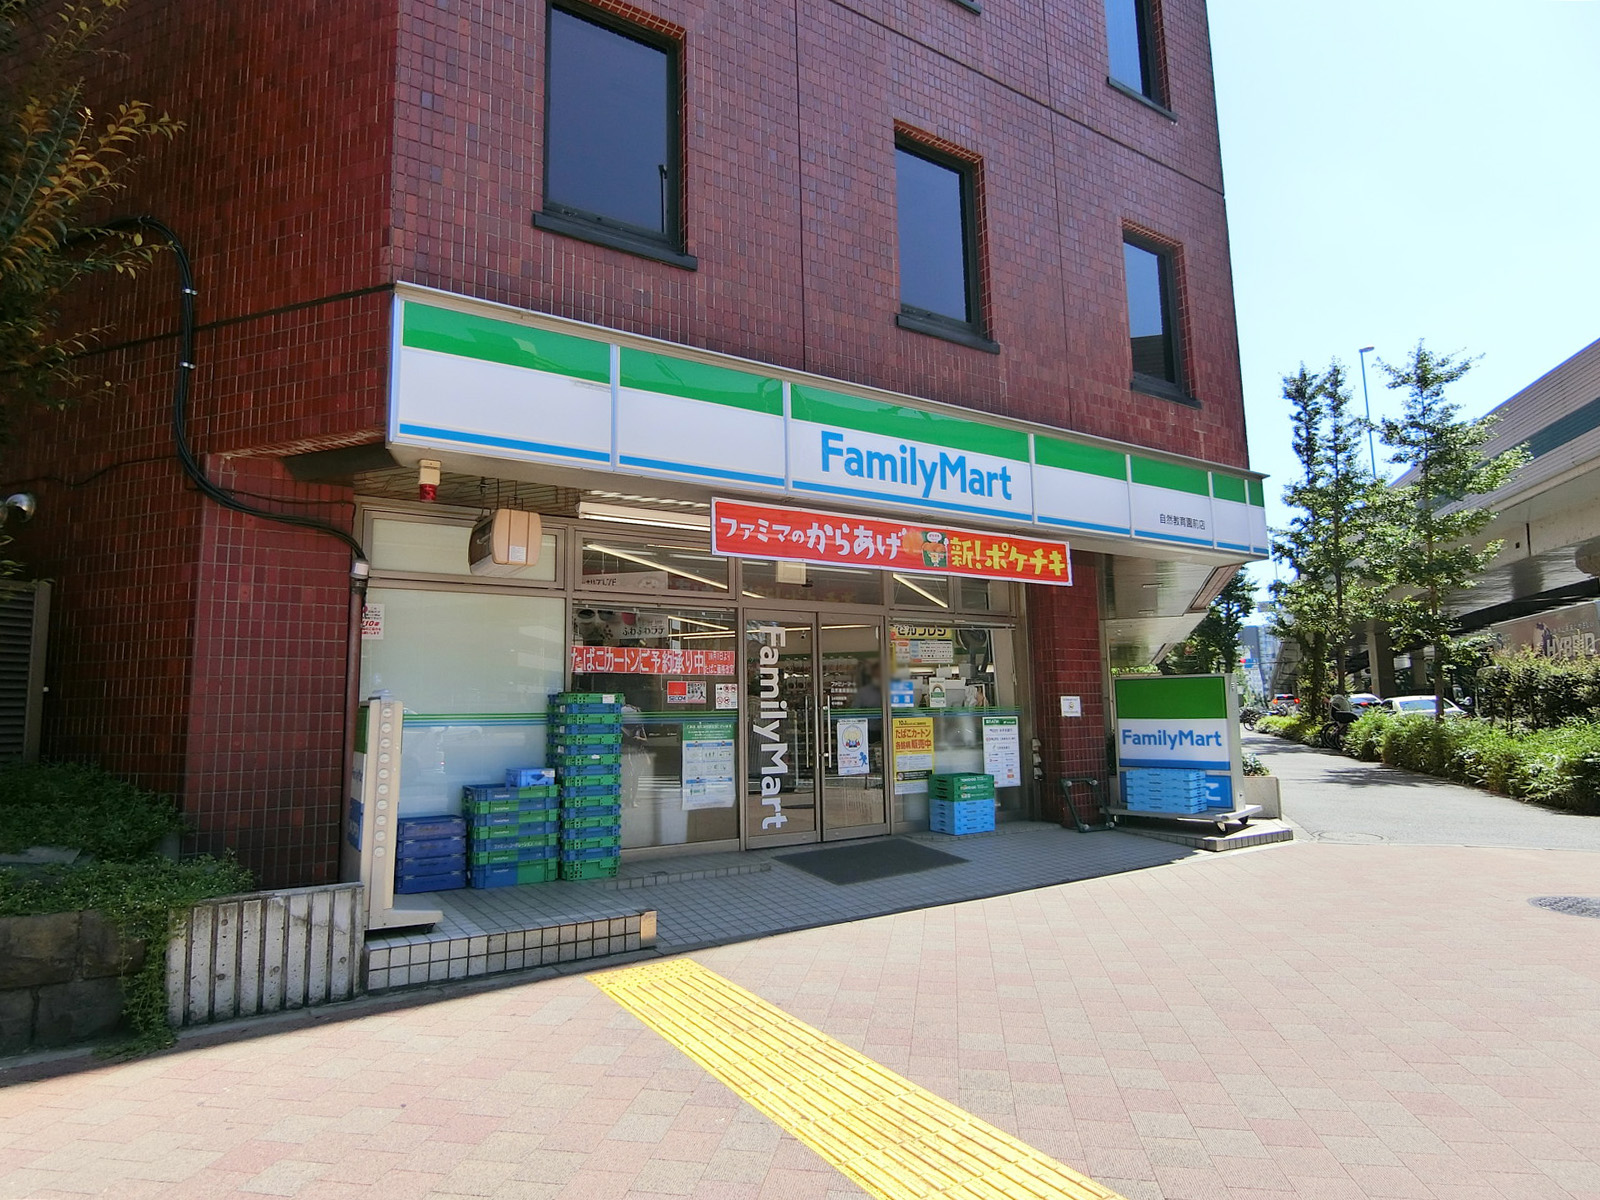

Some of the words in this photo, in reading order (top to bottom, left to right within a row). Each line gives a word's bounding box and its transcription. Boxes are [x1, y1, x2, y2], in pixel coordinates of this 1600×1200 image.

[821, 430, 1012, 501] FamilyMart
[1159, 513, 1206, 530] 自然教育園前店
[720, 517, 907, 560] ファミマのからあげ
[571, 646, 704, 674] たばこカートンご予約承り中
[753, 625, 789, 830] FamilyMart
[895, 728, 932, 739] たばこカートン
[1121, 729, 1223, 750] FamilyMart
